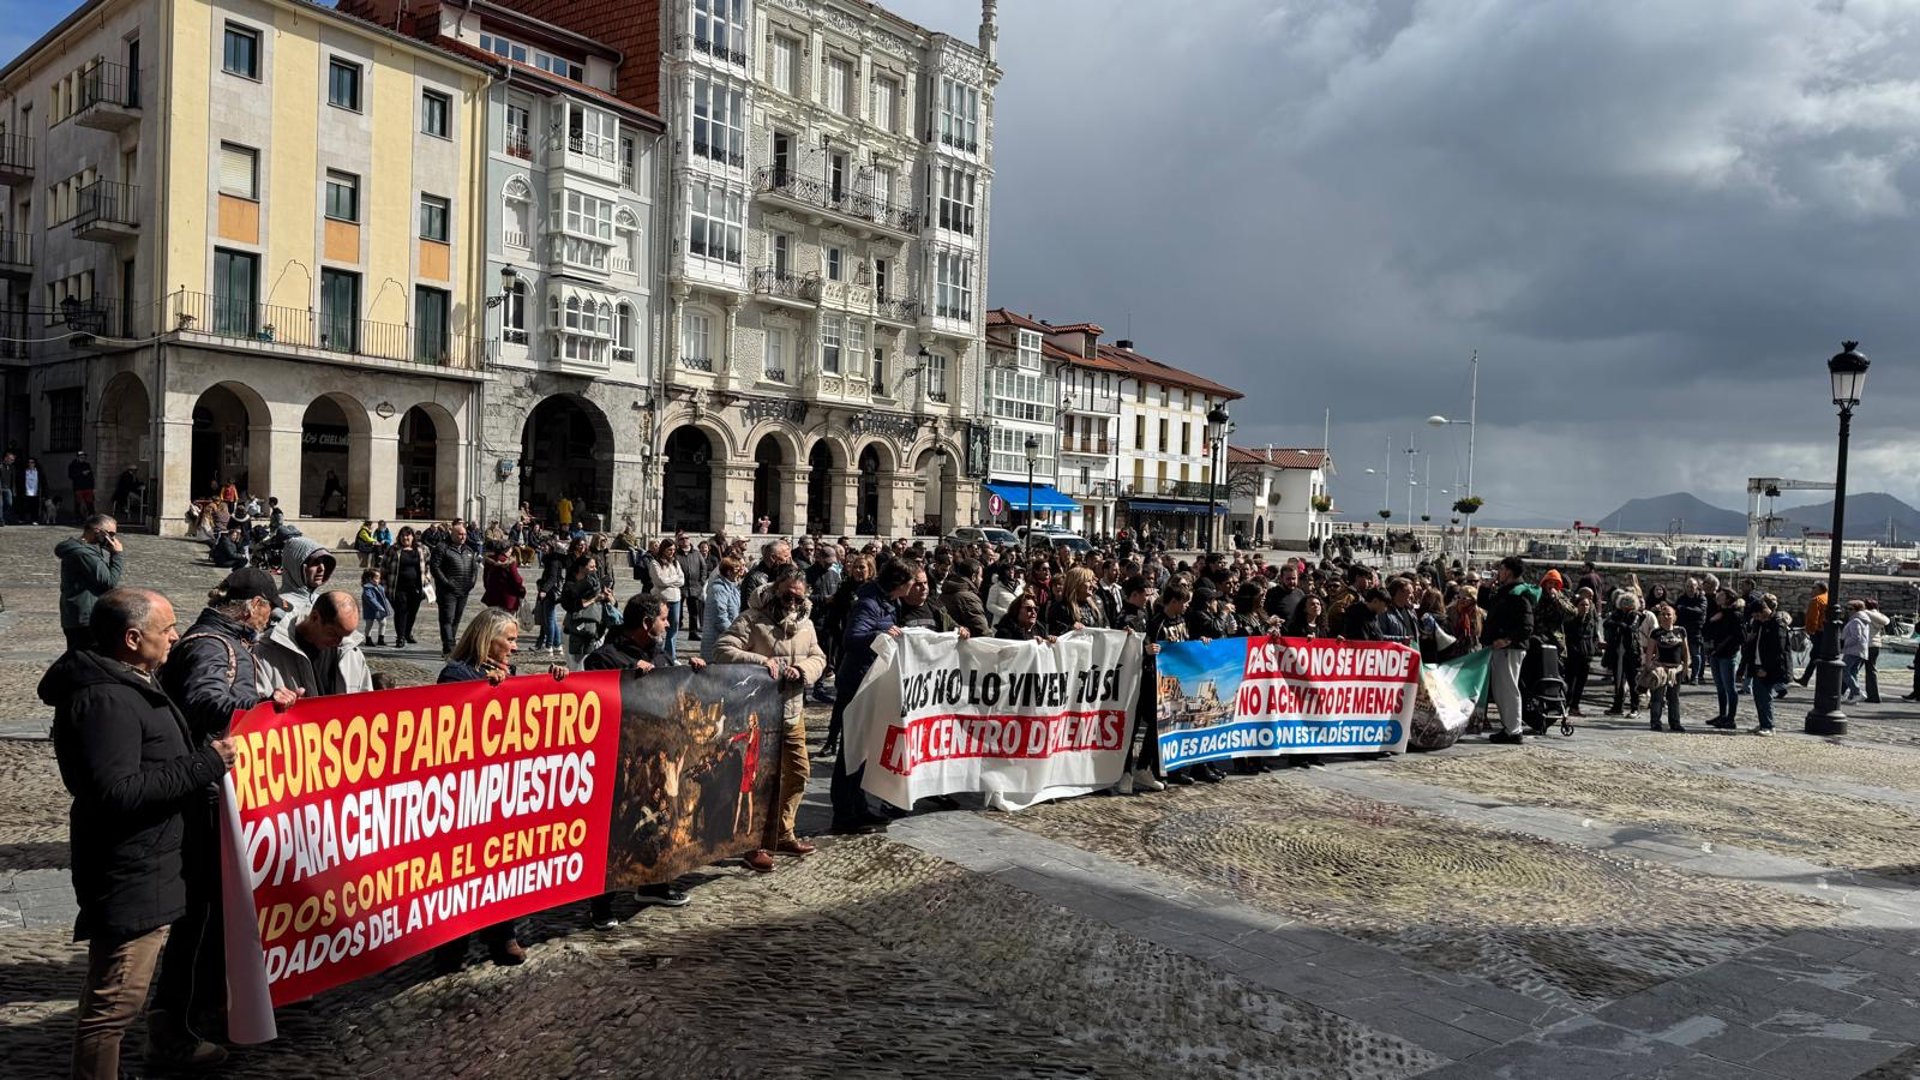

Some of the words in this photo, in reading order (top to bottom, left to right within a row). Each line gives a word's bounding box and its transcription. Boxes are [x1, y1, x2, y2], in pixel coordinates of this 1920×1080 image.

[1310, 647, 1335, 676] NO
[1336, 648, 1354, 676] SE
[1355, 648, 1412, 677] VENDE
[932, 668, 963, 705] NO
[968, 669, 1001, 707] LO
[1100, 663, 1123, 702] SÍ
[1238, 685, 1262, 716] NO
[1278, 685, 1335, 715] CENTRO
[1335, 686, 1351, 714] DE
[1352, 686, 1404, 715] MENAS
[234, 713, 389, 811] RECURSOS
[393, 703, 474, 774] PARA
[481, 690, 601, 757] CASTRO
[929, 718, 1022, 757] CENTRO
[1162, 740, 1179, 761] NO
[1180, 737, 1199, 757] ES
[1200, 728, 1274, 754] RACISMO
[1295, 721, 1393, 744] ESTADÍSTICAS
[272, 799, 340, 886] PARA
[341, 773, 457, 861] CENTROS
[457, 750, 596, 830] IMPUESTOS
[342, 851, 444, 918] CONTRA
[451, 843, 476, 880] EL
[483, 818, 587, 868] CENTRO
[369, 904, 402, 951] DEL
[406, 851, 584, 934] AYUNTAMIENTO
